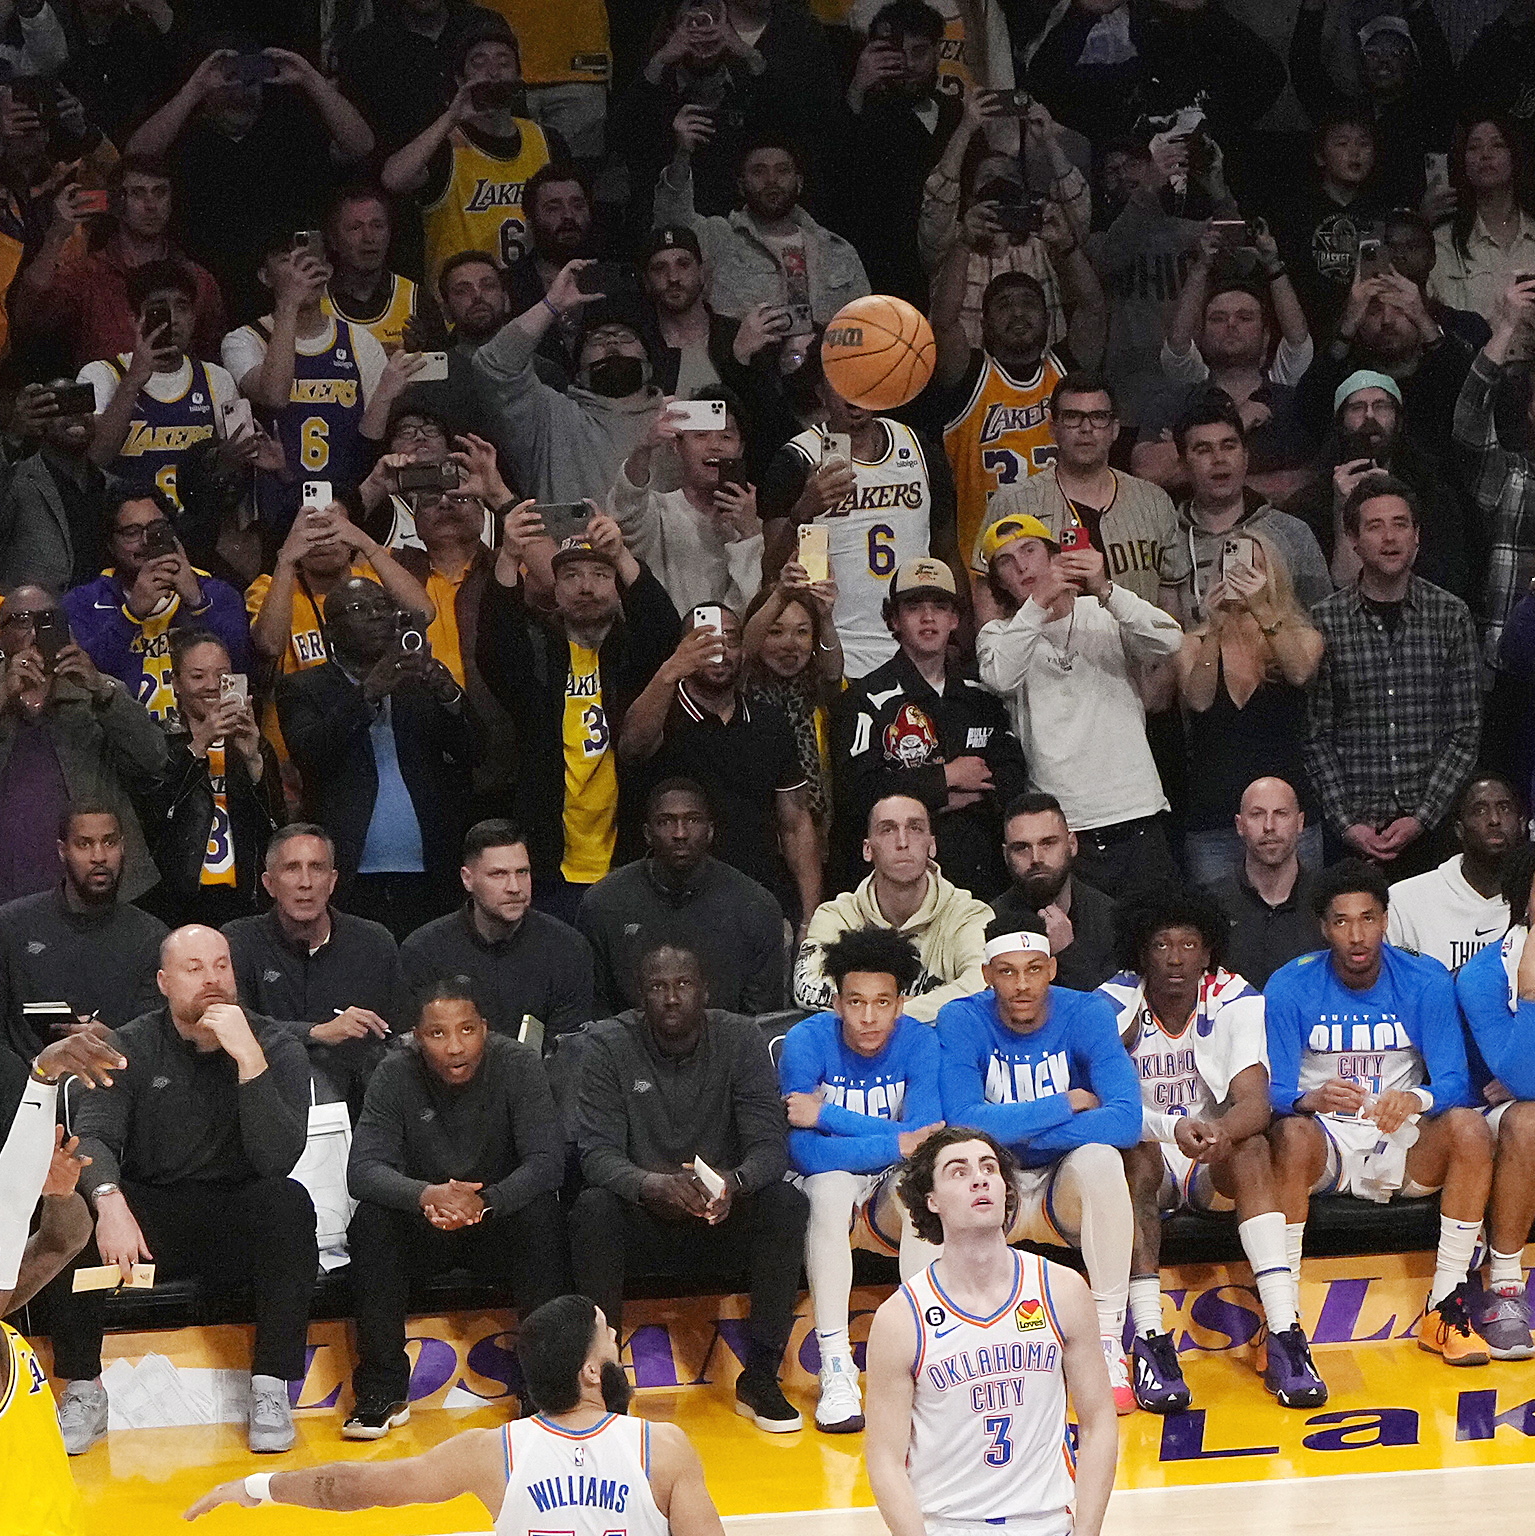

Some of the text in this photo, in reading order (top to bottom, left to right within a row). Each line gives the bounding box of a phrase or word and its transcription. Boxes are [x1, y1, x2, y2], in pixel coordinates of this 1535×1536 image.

[499, 218, 526, 266] 6
[300, 416, 330, 473] 6
[865, 523, 894, 577] 6
[1337, 1055, 1385, 1077] CITY
[1155, 1077, 1200, 1104] CITY
[930, 1307, 941, 1323] 6
[925, 1338, 1058, 1392] OKLAHOMA
[970, 1377, 1025, 1414] CITY
[982, 1413, 1014, 1469] 3
[526, 1478, 630, 1515] WILLIAMS
